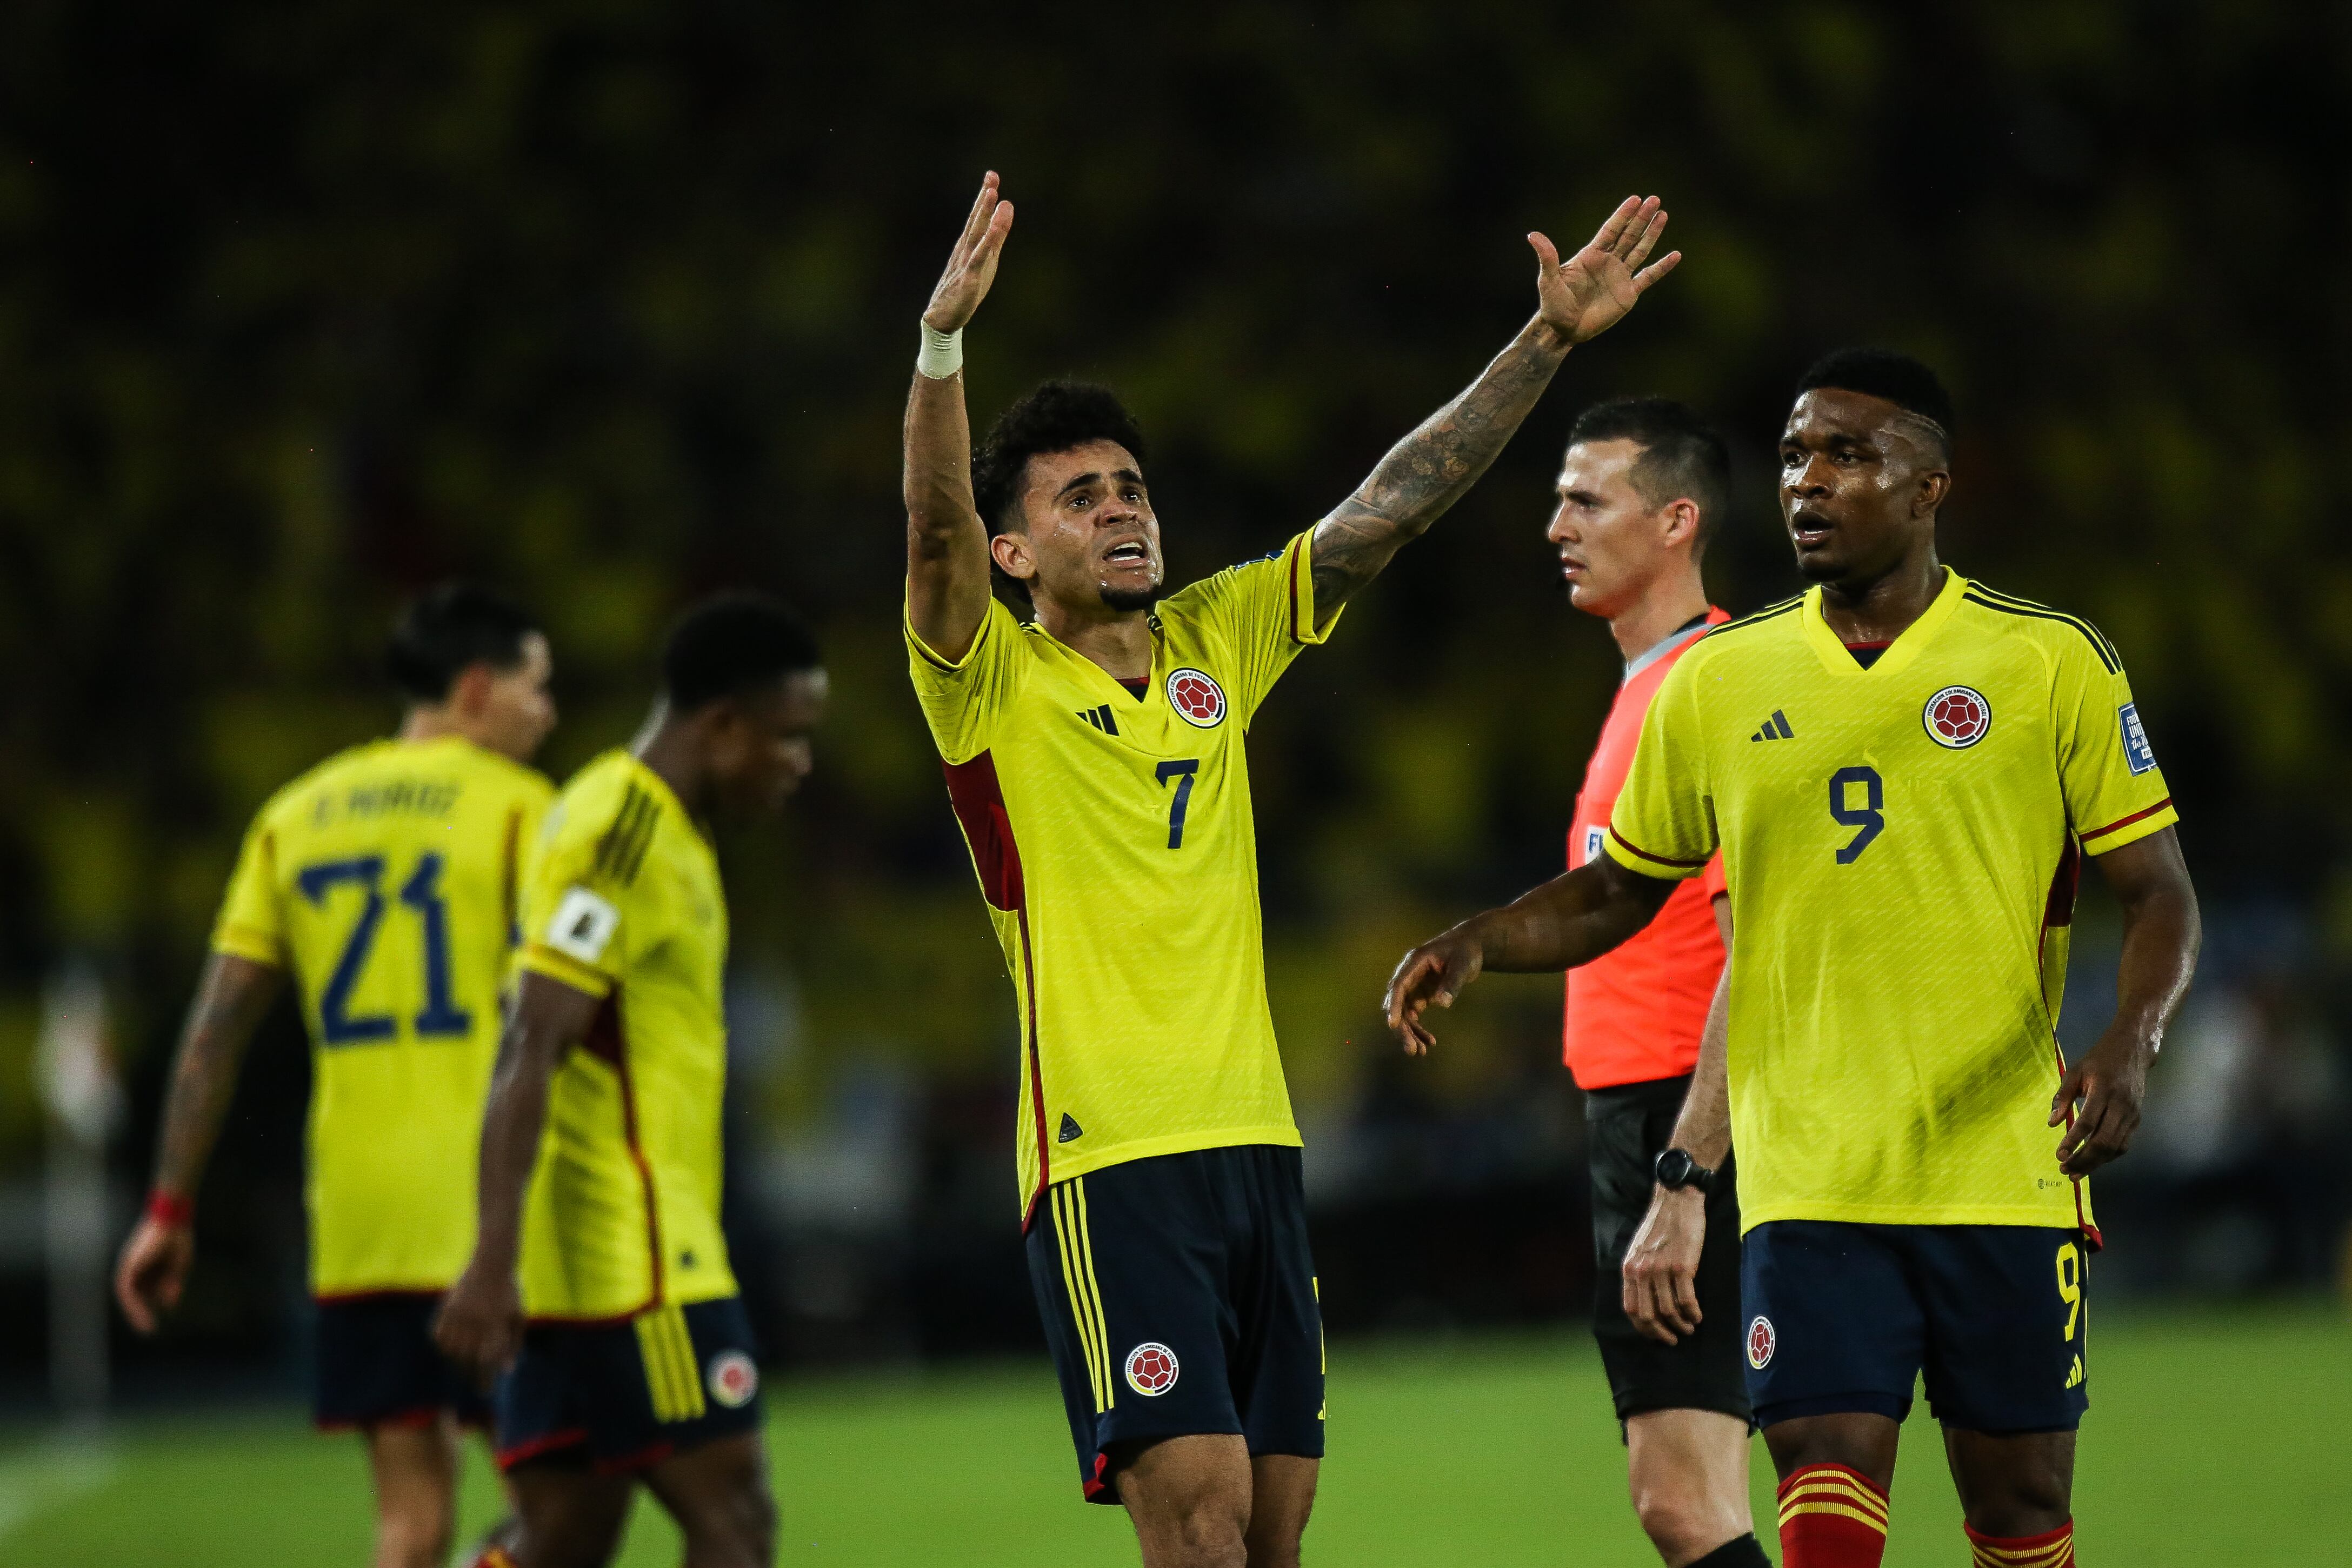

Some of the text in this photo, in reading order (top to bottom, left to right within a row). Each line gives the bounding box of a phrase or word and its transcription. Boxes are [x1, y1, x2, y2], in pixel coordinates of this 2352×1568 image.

[1155, 758, 1200, 849] 7
[1829, 766, 1885, 865] 9
[298, 853, 475, 1045] 21
[2056, 1242, 2080, 1342] 9
